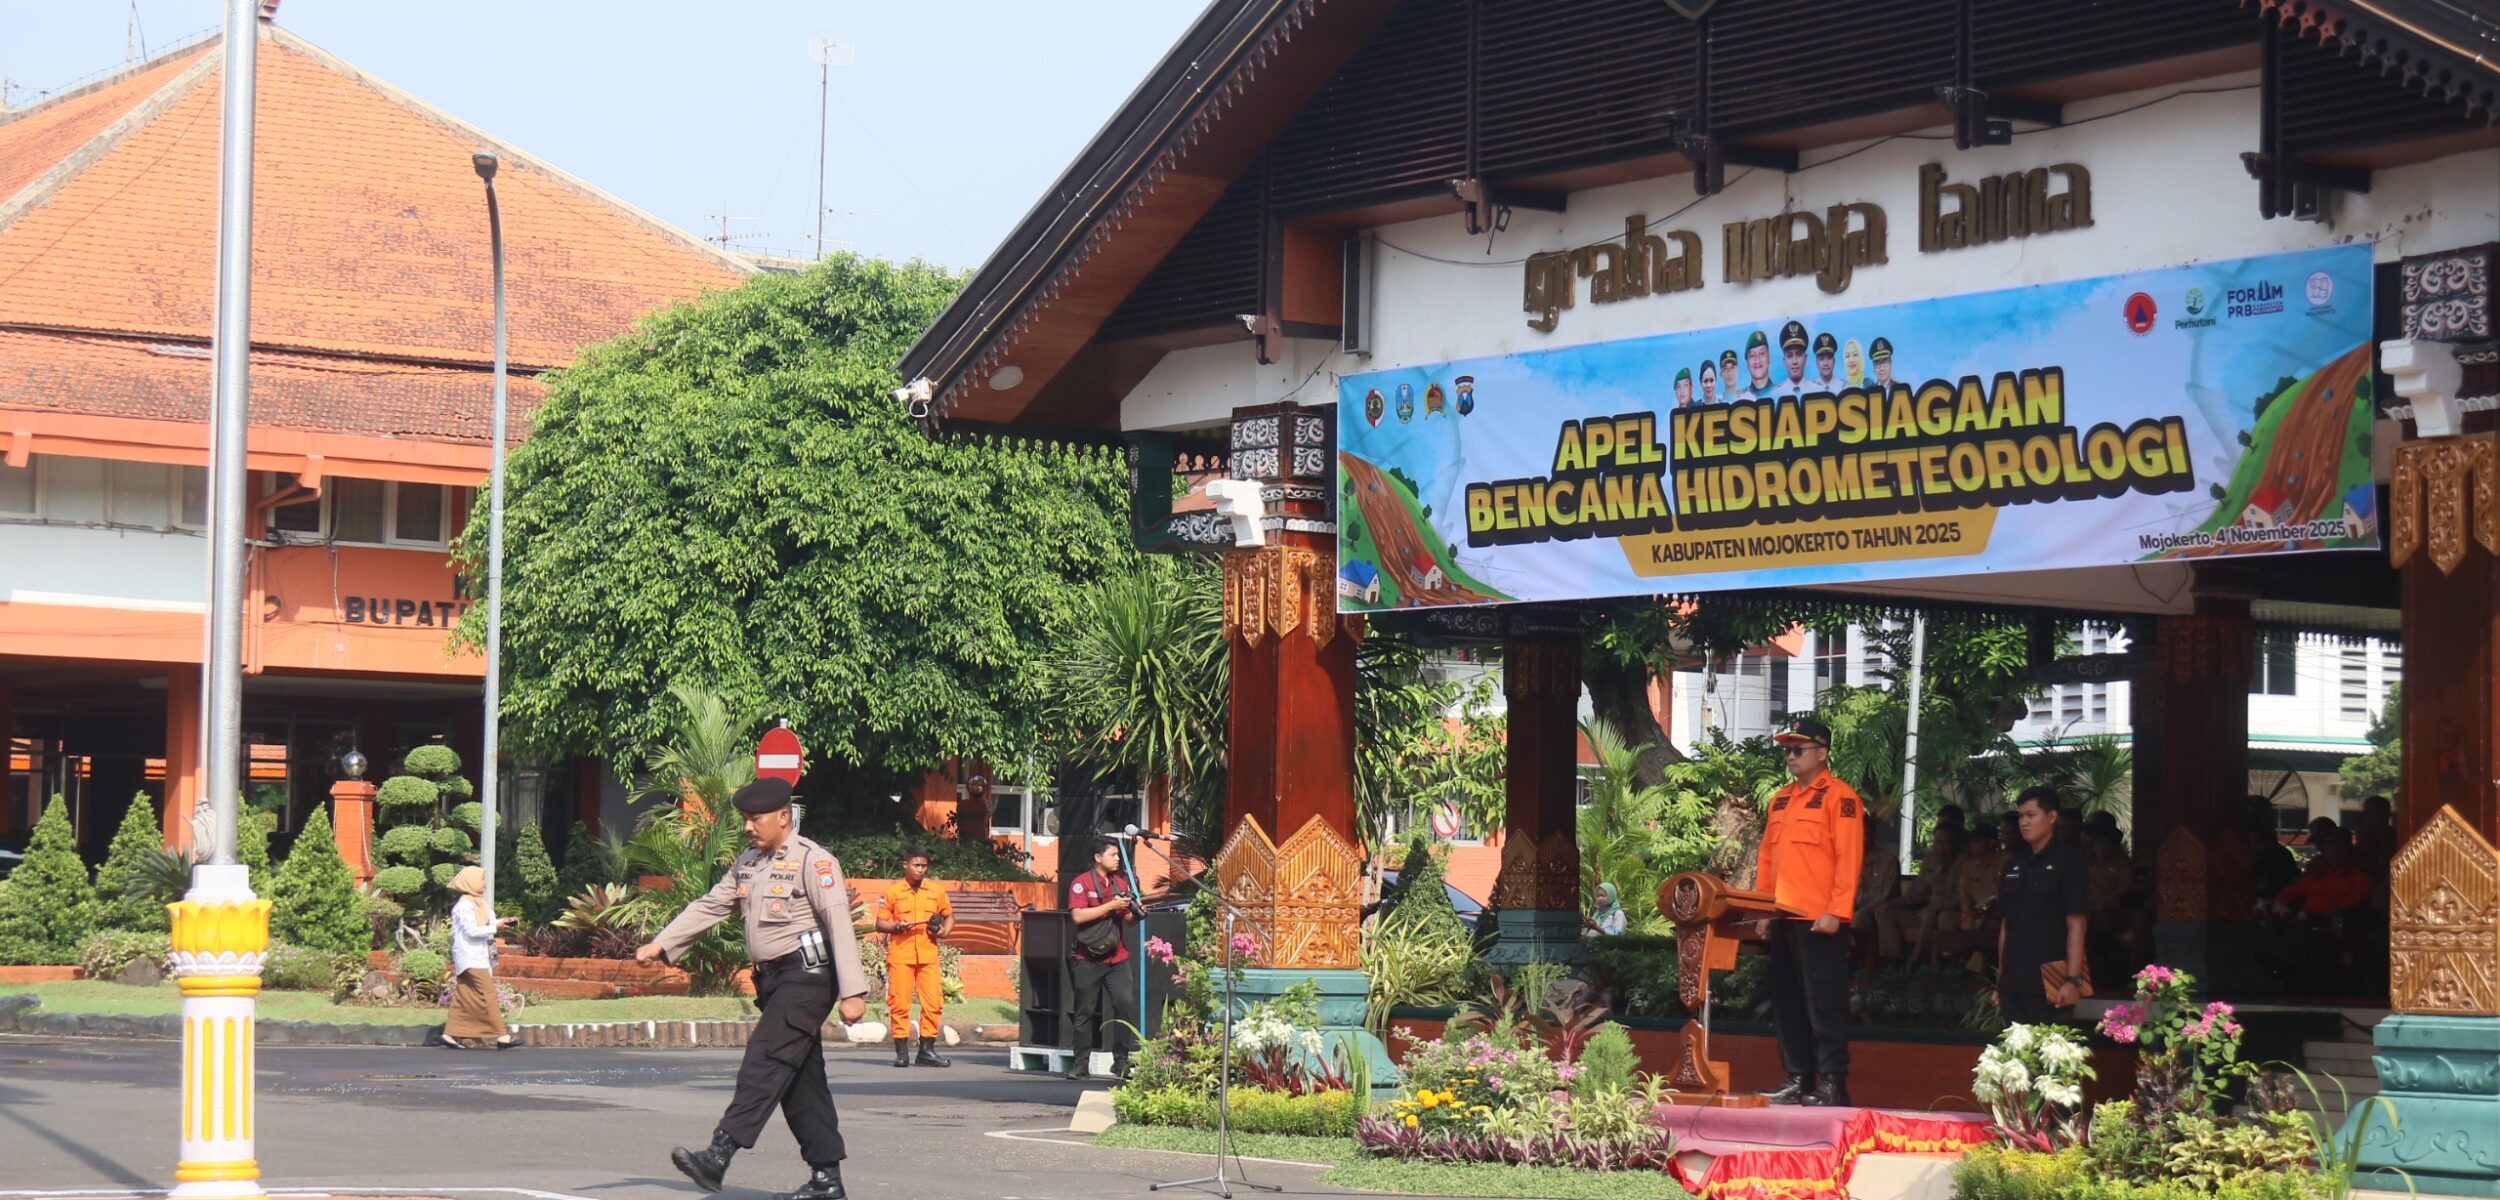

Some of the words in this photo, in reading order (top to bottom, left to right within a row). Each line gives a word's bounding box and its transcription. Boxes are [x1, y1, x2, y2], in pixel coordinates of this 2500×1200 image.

[2227, 279, 2283, 304] FORUM
[2175, 316, 2217, 330] Perhutani
[2227, 304, 2253, 318] PRB
[1556, 417, 1663, 472] APEL
[1674, 372, 2060, 460] KESIAPSIAGAAN
[1468, 473, 1668, 532] BENCANA
[1676, 422, 2188, 515] HIDROMETEOROLOGI
[1651, 539, 1745, 563] KABUPATEN
[1750, 530, 1849, 556] MOJOKERTO
[1852, 524, 1912, 549] TAHUN
[1915, 522, 1961, 544] 2025
[2139, 533, 2214, 551] Mojokerto,
[2216, 530, 2226, 544] 4
[2231, 524, 2305, 543] November
[2308, 521, 2346, 538] 2025
[769, 873, 795, 881] POLRI
